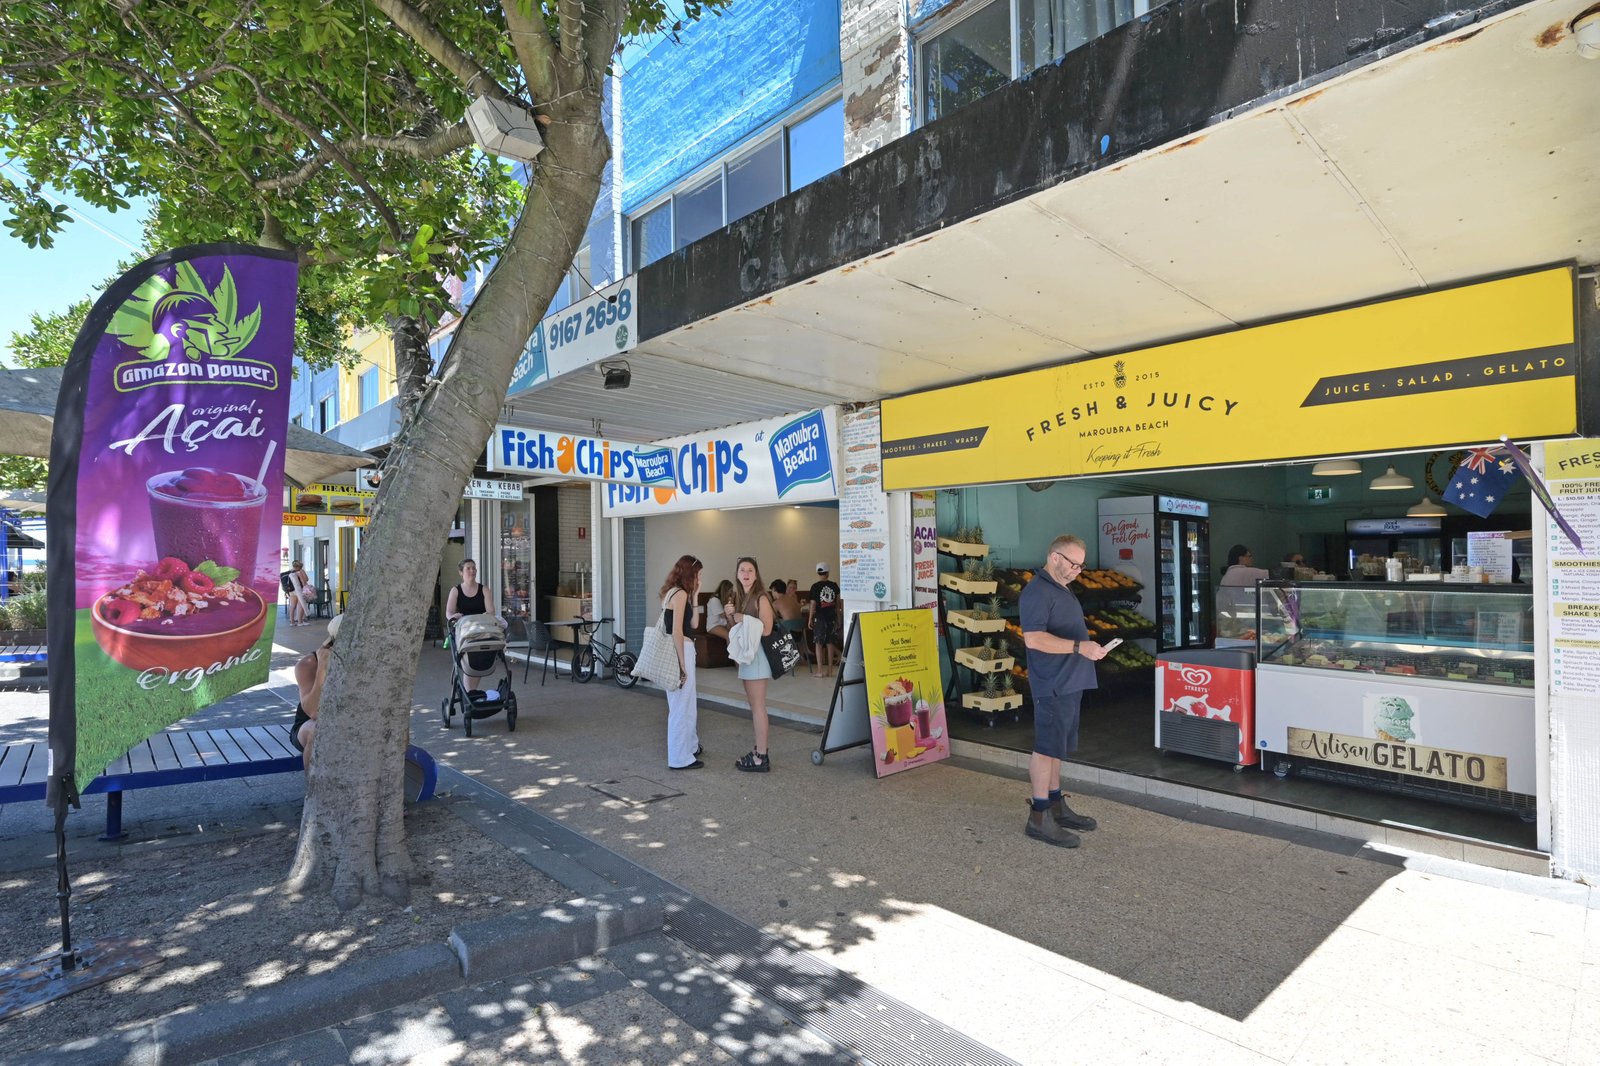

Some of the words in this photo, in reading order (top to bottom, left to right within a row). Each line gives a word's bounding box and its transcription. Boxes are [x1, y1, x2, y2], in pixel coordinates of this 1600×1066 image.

[550, 312, 582, 350] 9167
[585, 288, 631, 335] 2658
[122, 363, 203, 383] amazon
[207, 364, 270, 382] power
[1135, 371, 1160, 381] 2015
[1325, 382, 1371, 396] JUICE
[1397, 372, 1453, 387] SALAD
[1483, 357, 1565, 376] GELATO
[1084, 381, 1105, 390] ESTD
[192, 400, 256, 420] original
[1026, 401, 1098, 442] FRESH
[1116, 395, 1127, 410] &
[1147, 392, 1238, 416] JUICY
[109, 404, 265, 456] Açai
[755, 430, 765, 443] at
[1079, 425, 1131, 438] MAROUBRA
[1135, 420, 1169, 431] BEACH
[774, 423, 820, 462] Maroubra
[923, 440, 947, 449] SHAKES
[955, 436, 978, 444] WRAPS
[501, 429, 555, 469] Fish
[576, 439, 635, 479] Chips
[636, 454, 669, 468] Maroubra
[783, 441, 817, 478] Beach
[1086, 445, 1121, 468] Keeping
[1123, 446, 1132, 460] it
[1132, 441, 1163, 459] Fresh
[645, 465, 667, 478] Beach
[677, 439, 749, 495] Chips
[498, 482, 520, 491] KEBAB
[283, 514, 307, 522] STOP
[914, 526, 936, 540] ACAI
[1102, 522, 1116, 535] Do
[1111, 532, 1127, 545] Feel
[915, 560, 934, 571] FRESH
[917, 569, 934, 580] JUICE
[136, 648, 263, 692] Organic
[1184, 685, 1208, 693] STREETS
[1301, 733, 1373, 761] Artisan
[1373, 742, 1485, 782] GELATO
